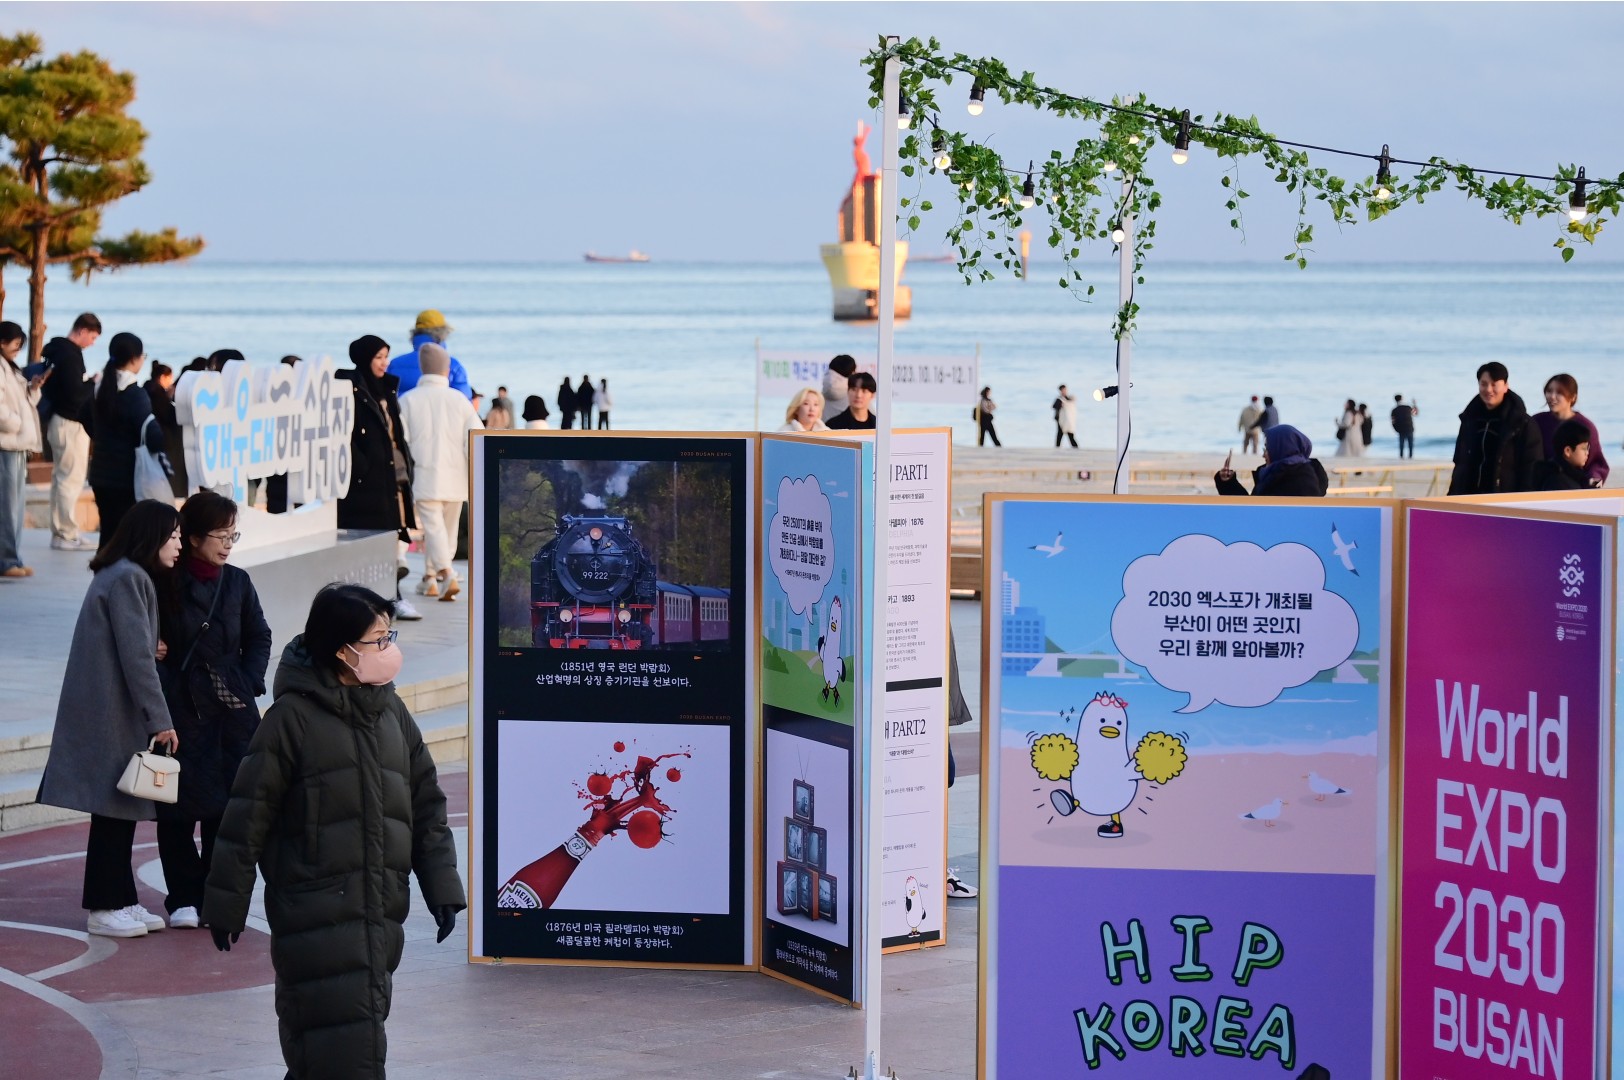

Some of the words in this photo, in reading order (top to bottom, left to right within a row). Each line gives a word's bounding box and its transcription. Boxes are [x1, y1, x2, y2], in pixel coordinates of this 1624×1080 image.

[895, 464, 928, 481] PART1
[911, 518, 924, 526] 1876
[595, 572, 608, 580] 222
[1148, 590, 1192, 607] 2030
[1197, 591, 1260, 610] 엑스포가
[1265, 592, 1313, 610] 개최될
[1164, 615, 1211, 633] 부산이
[1216, 616, 1248, 634] 어떤
[1253, 616, 1300, 634] 곳인지
[1159, 640, 1190, 657] 우리
[1196, 640, 1227, 658] 함께
[1232, 641, 1304, 658] 알아볼까?
[598, 662, 615, 673] 영국
[618, 662, 637, 673] 런던
[536, 674, 581, 686] 산업혁명의
[584, 675, 602, 686] 상징
[605, 676, 650, 687] 증기기관을
[653, 676, 692, 688] 선보이다.
[892, 719, 926, 738] PART2
[1435, 678, 1568, 778] World
[1436, 778, 1566, 884] EXPO
[514, 888, 534, 908] HEINZ
[584, 922, 601, 933] 미국
[605, 924, 650, 934] 필라델피아
[1434, 880, 1566, 994] 2030
[556, 936, 601, 946] 새콤달콤한
[634, 938, 673, 948] 등장하다.
[1100, 914, 1284, 987] HIP
[1073, 995, 1296, 1071] KOREA
[1434, 986, 1564, 1080] BUSAN
